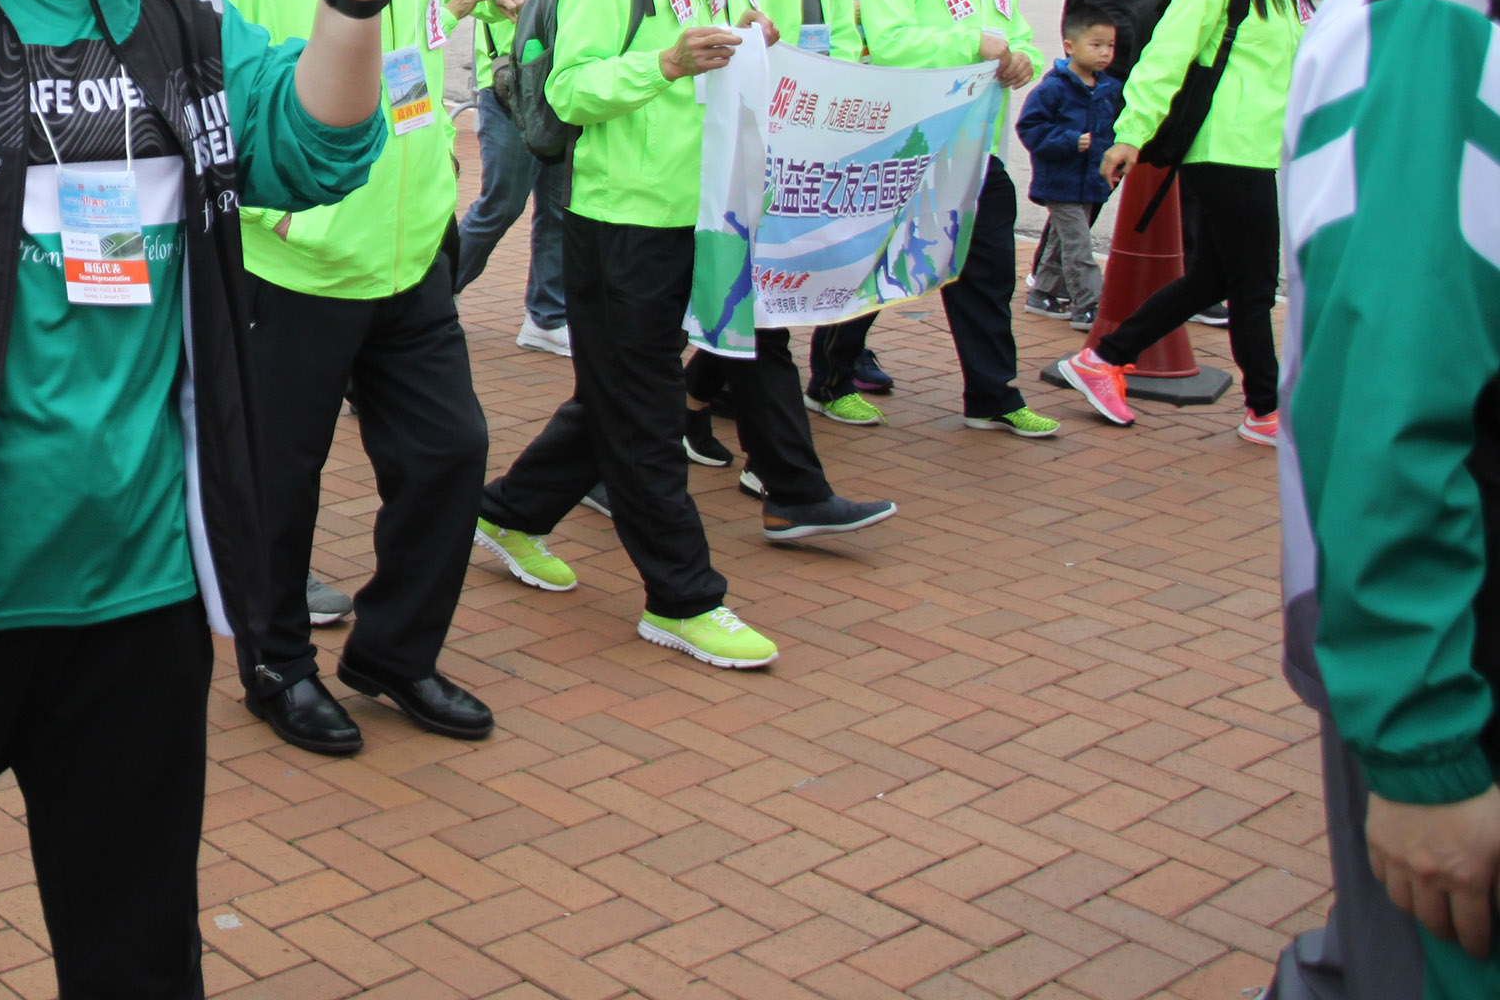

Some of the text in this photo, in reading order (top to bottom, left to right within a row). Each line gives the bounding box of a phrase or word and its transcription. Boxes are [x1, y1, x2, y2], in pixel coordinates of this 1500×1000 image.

[78, 77, 142, 112] OVE
[414, 103, 426, 116] VIP
[92, 274, 130, 282] Representative
